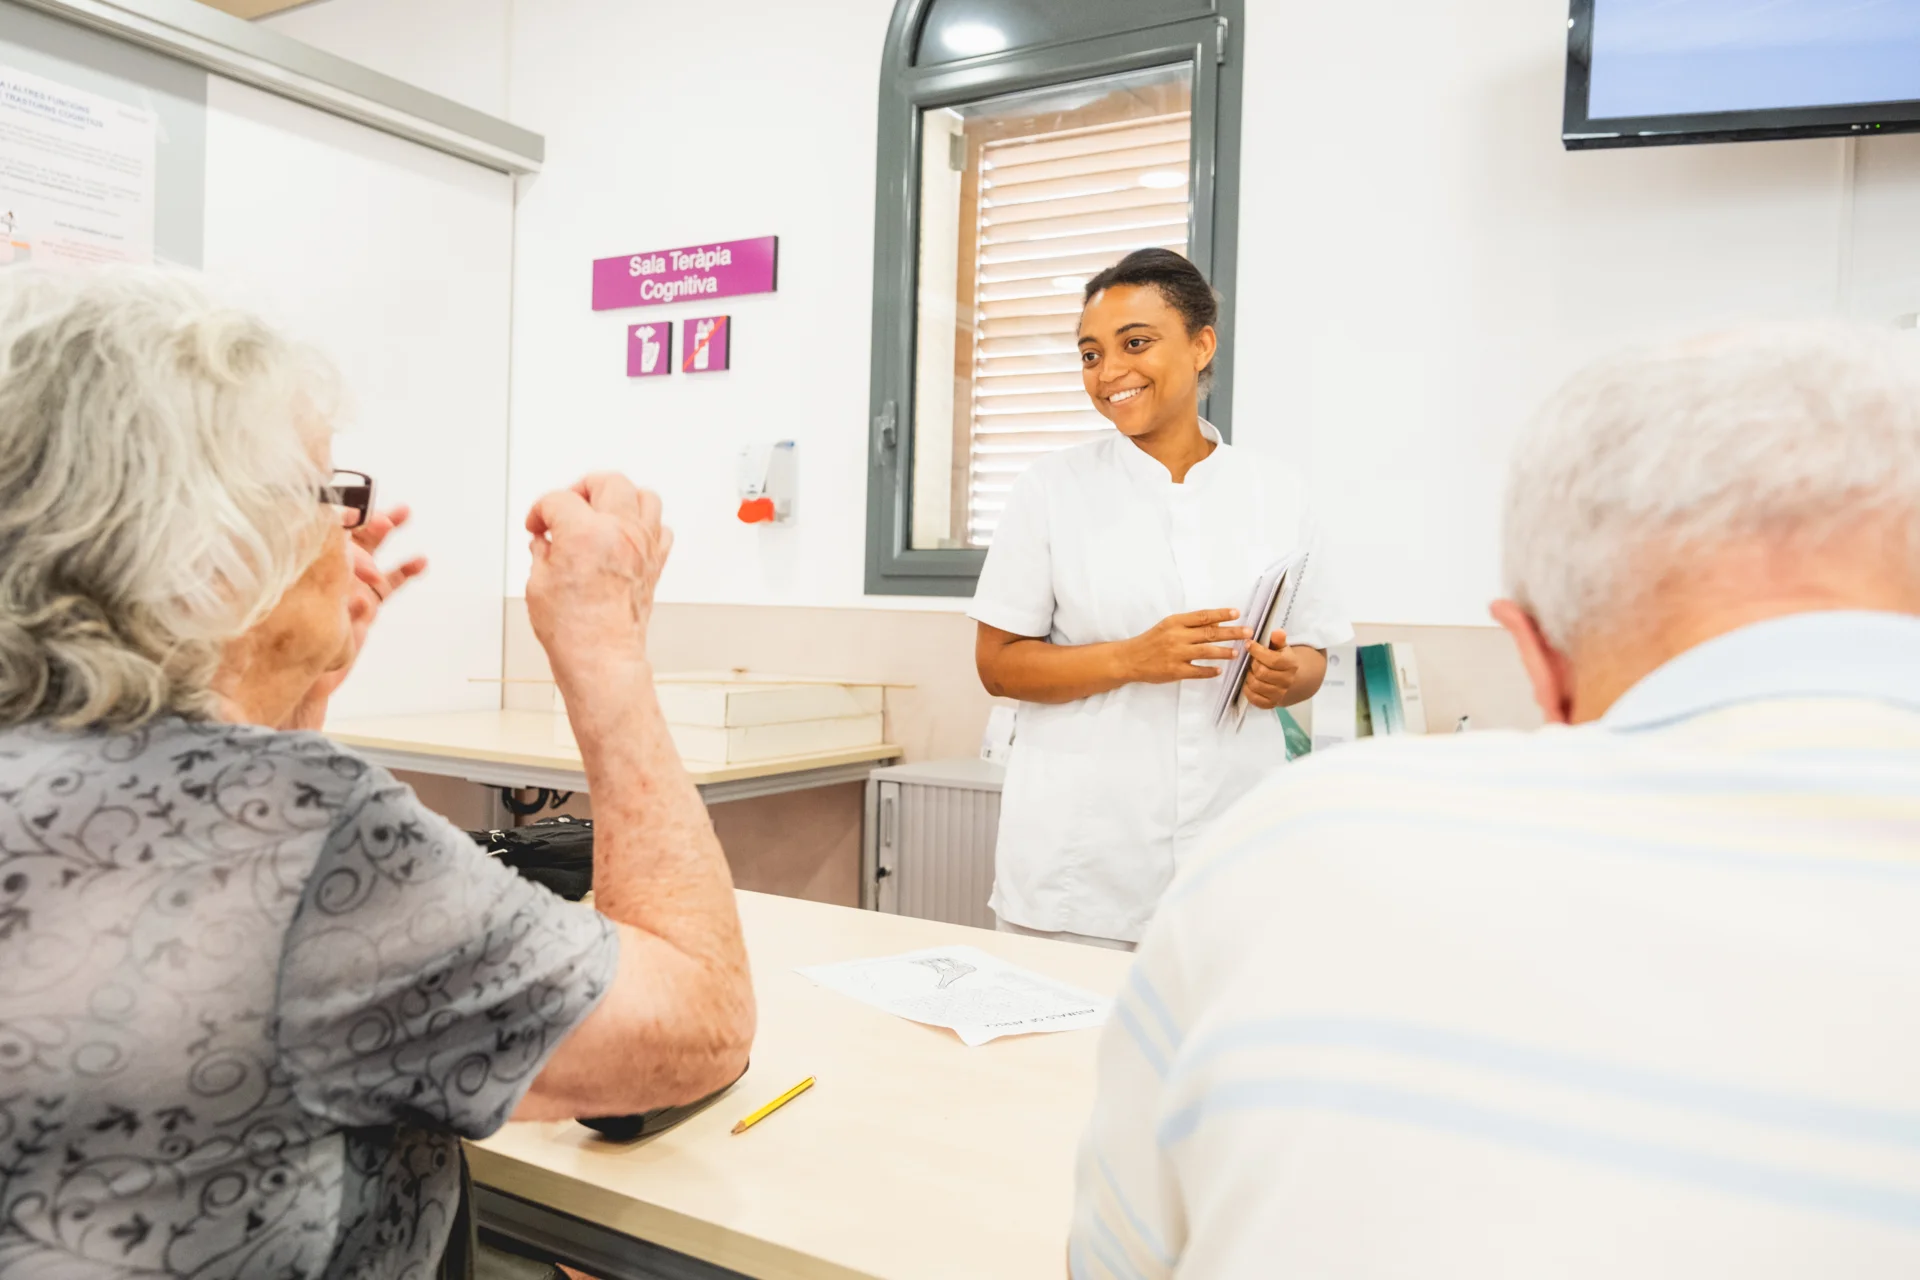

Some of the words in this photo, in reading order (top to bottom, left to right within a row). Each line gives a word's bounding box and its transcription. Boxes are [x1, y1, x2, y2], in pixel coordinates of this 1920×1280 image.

[629, 254, 666, 277] Sala
[669, 246, 732, 272] Teràpia
[640, 274, 718, 302] Cognitiva
